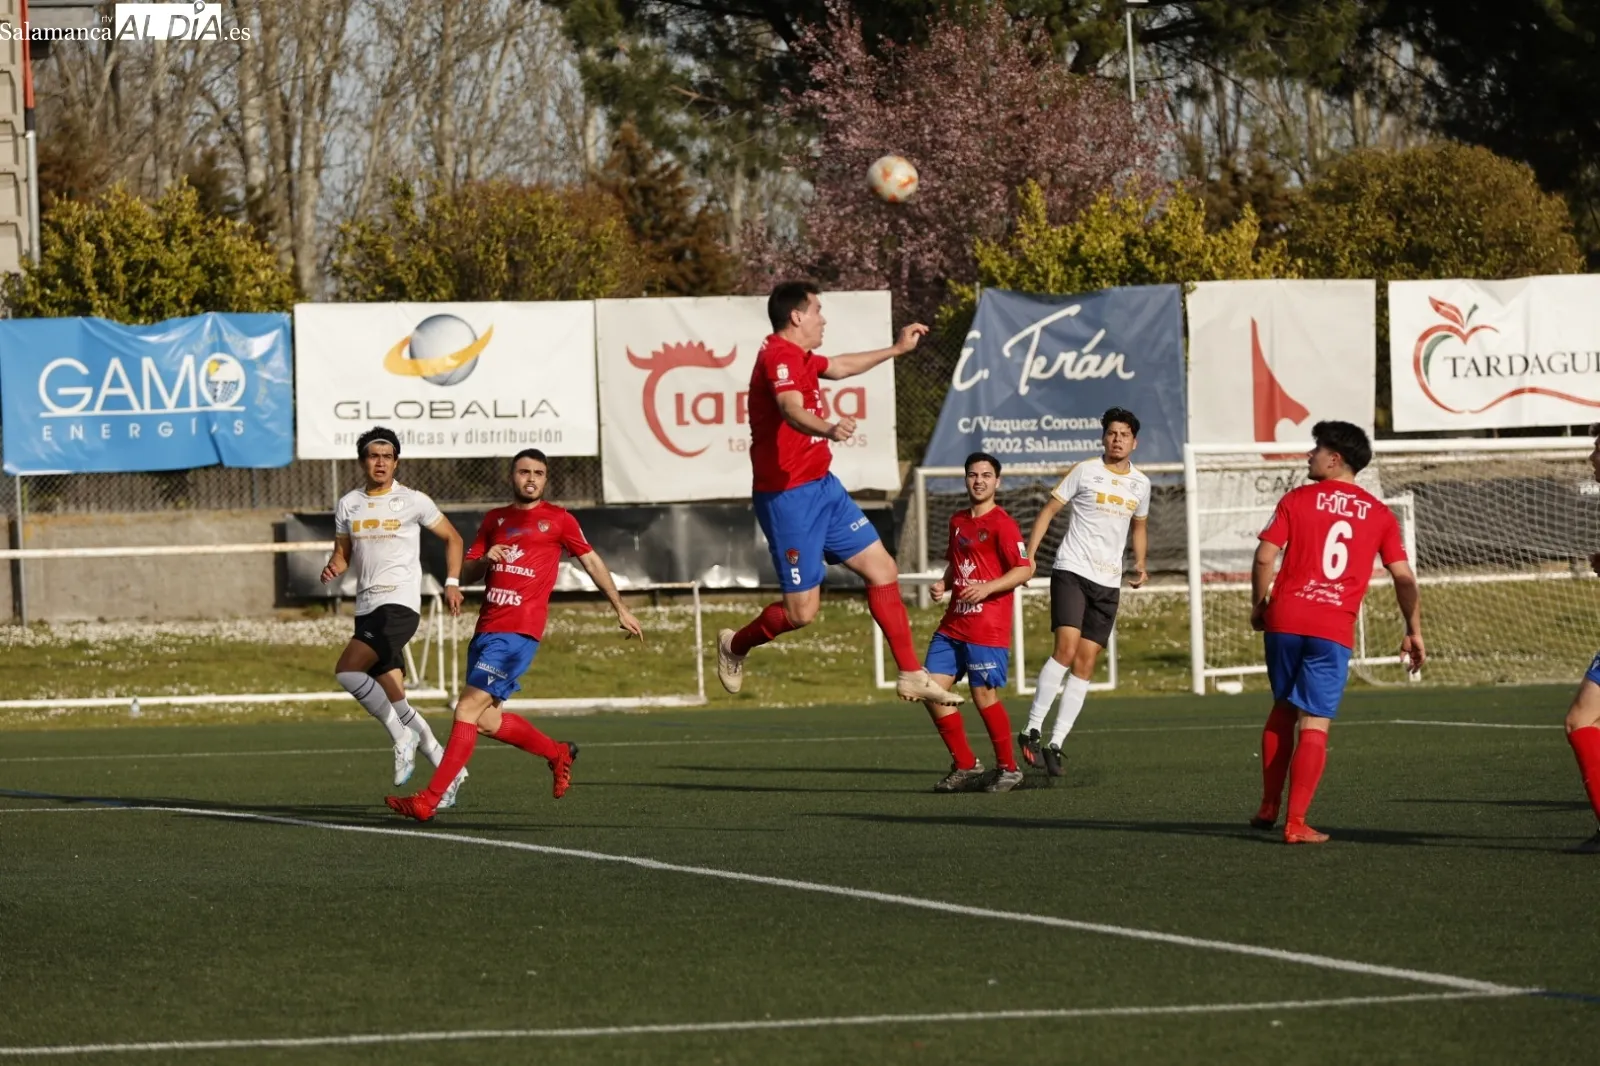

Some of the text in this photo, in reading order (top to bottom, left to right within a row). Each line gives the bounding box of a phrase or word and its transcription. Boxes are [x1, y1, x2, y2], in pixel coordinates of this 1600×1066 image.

[1002, 304, 1135, 395] Terán
[38, 352, 246, 413] GAMO
[334, 399, 560, 420] GLOBALIA
[451, 432, 458, 447] y
[465, 428, 563, 445] distribución
[1316, 492, 1372, 520] HLT
[1322, 520, 1353, 580] 6
[505, 564, 536, 578] RURAL
[791, 567, 802, 585] 5
[486, 591, 522, 606] ALIJAS
